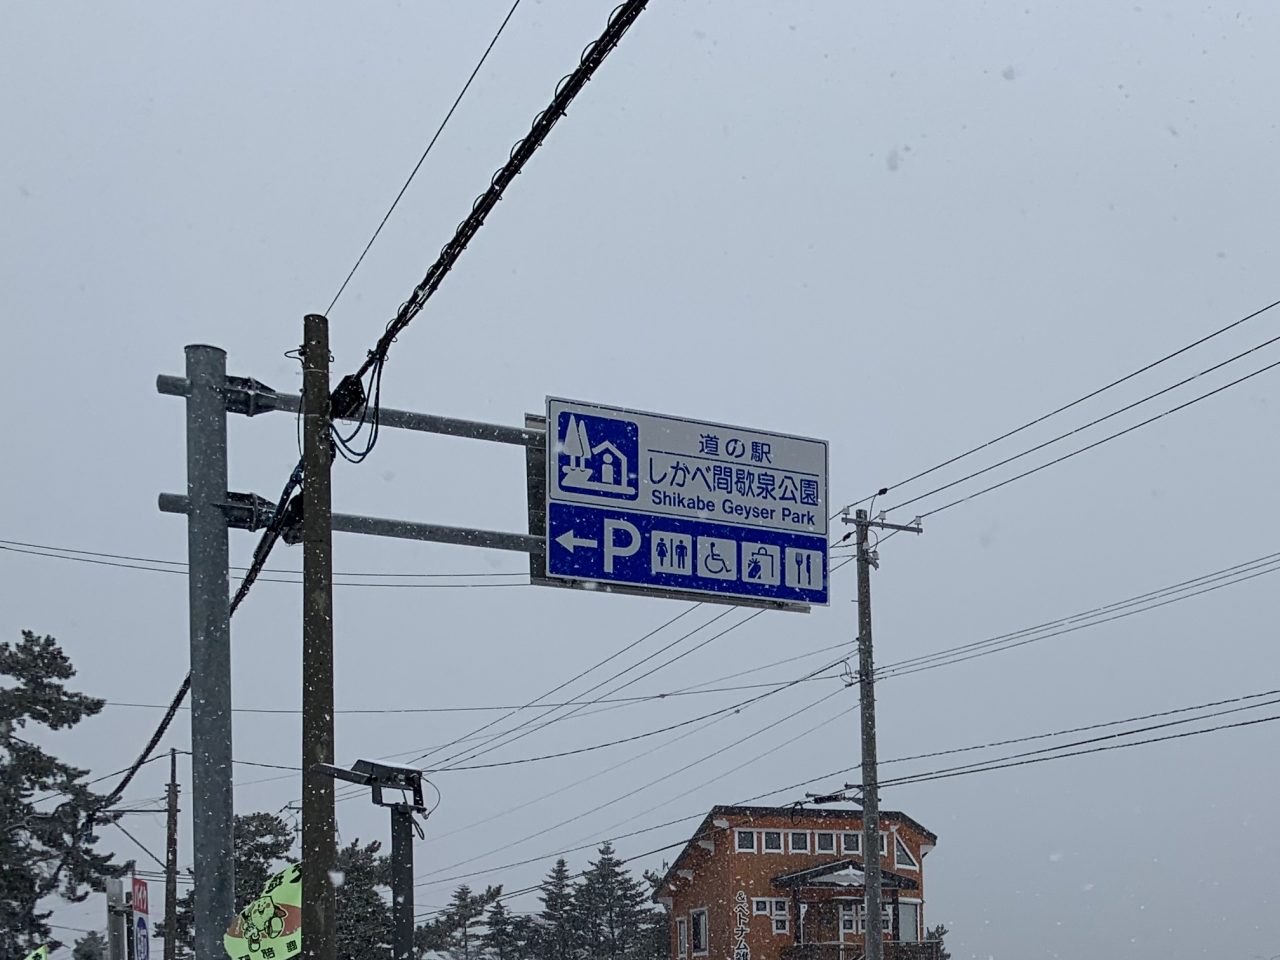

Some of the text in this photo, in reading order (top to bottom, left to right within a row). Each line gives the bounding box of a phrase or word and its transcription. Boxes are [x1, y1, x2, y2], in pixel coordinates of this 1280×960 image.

[699, 433, 771, 464] 道の駅
[649, 457, 819, 506] しかべ間歇泉公園
[651, 489, 815, 525] Shikabe Geyser Park
[604, 518, 642, 573] P
